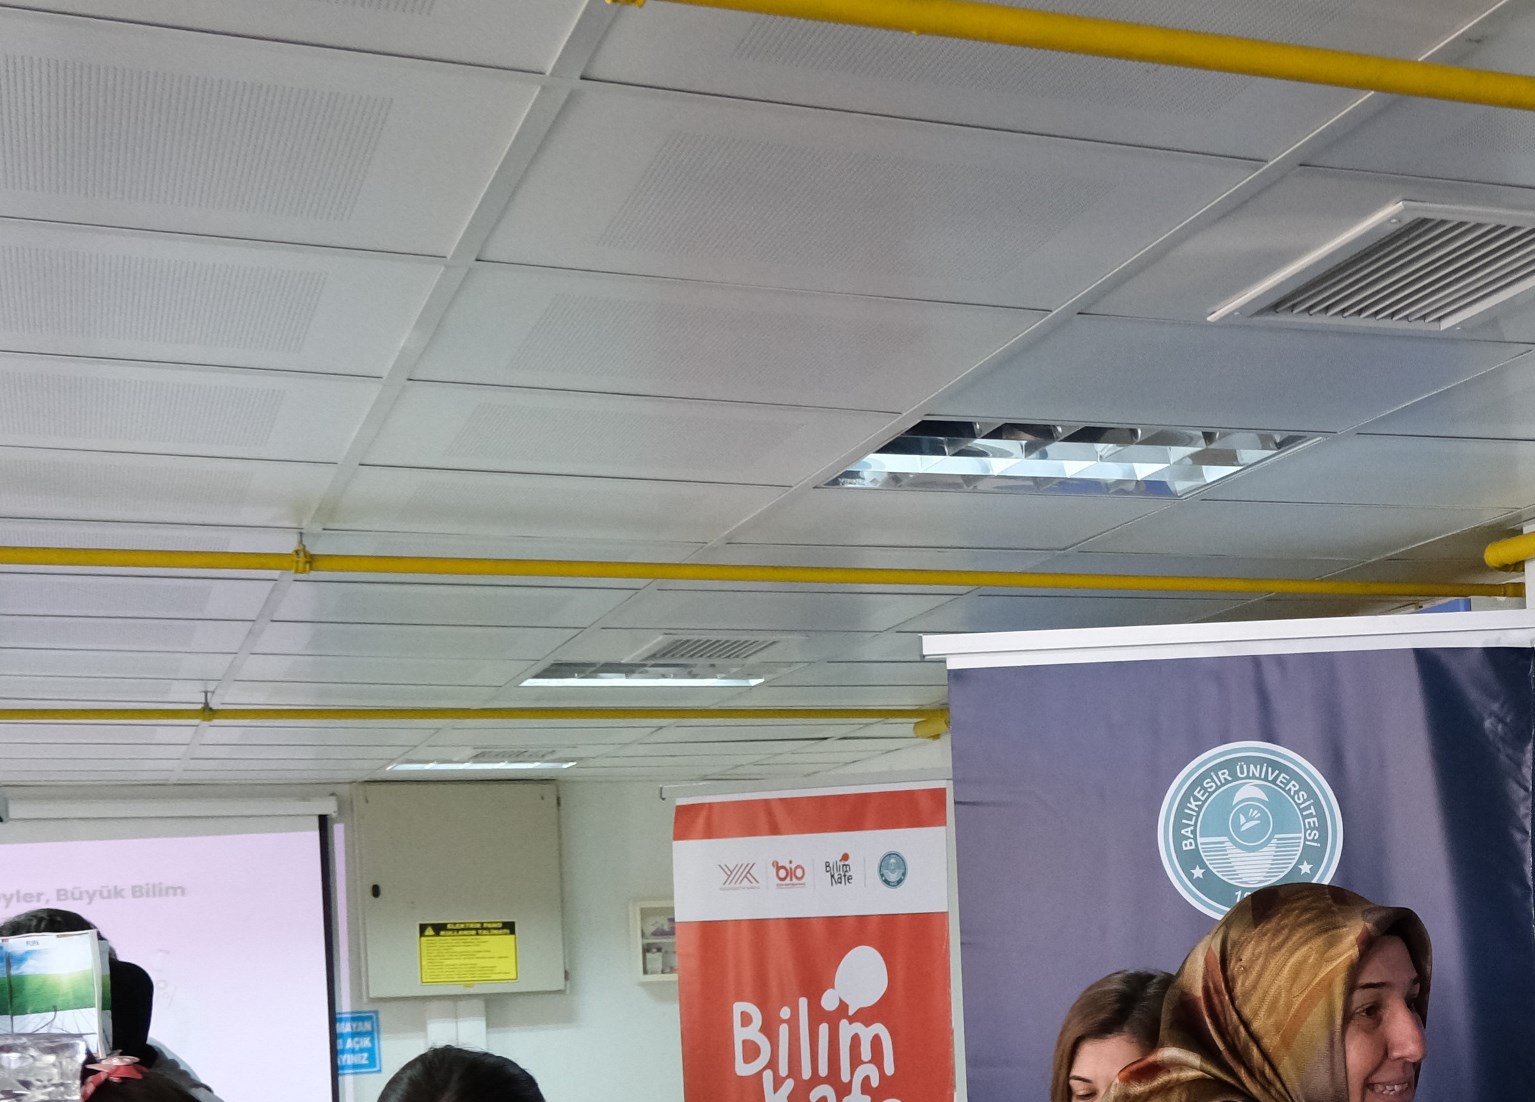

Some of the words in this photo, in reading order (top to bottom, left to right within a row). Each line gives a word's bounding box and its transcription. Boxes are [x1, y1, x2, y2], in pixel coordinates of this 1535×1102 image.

[1181, 769, 1232, 851] BALIKESİR
[1236, 762, 1321, 848] ÜNİVERSİTESİ
[773, 860, 806, 882] bio
[825, 860, 851, 873] Bilim
[830, 871, 853, 887] Kafe
[0, 889, 50, 908] yler,
[56, 885, 124, 905] Büyük
[131, 882, 186, 899] Bilim
[733, 990, 895, 1083] Bilim
